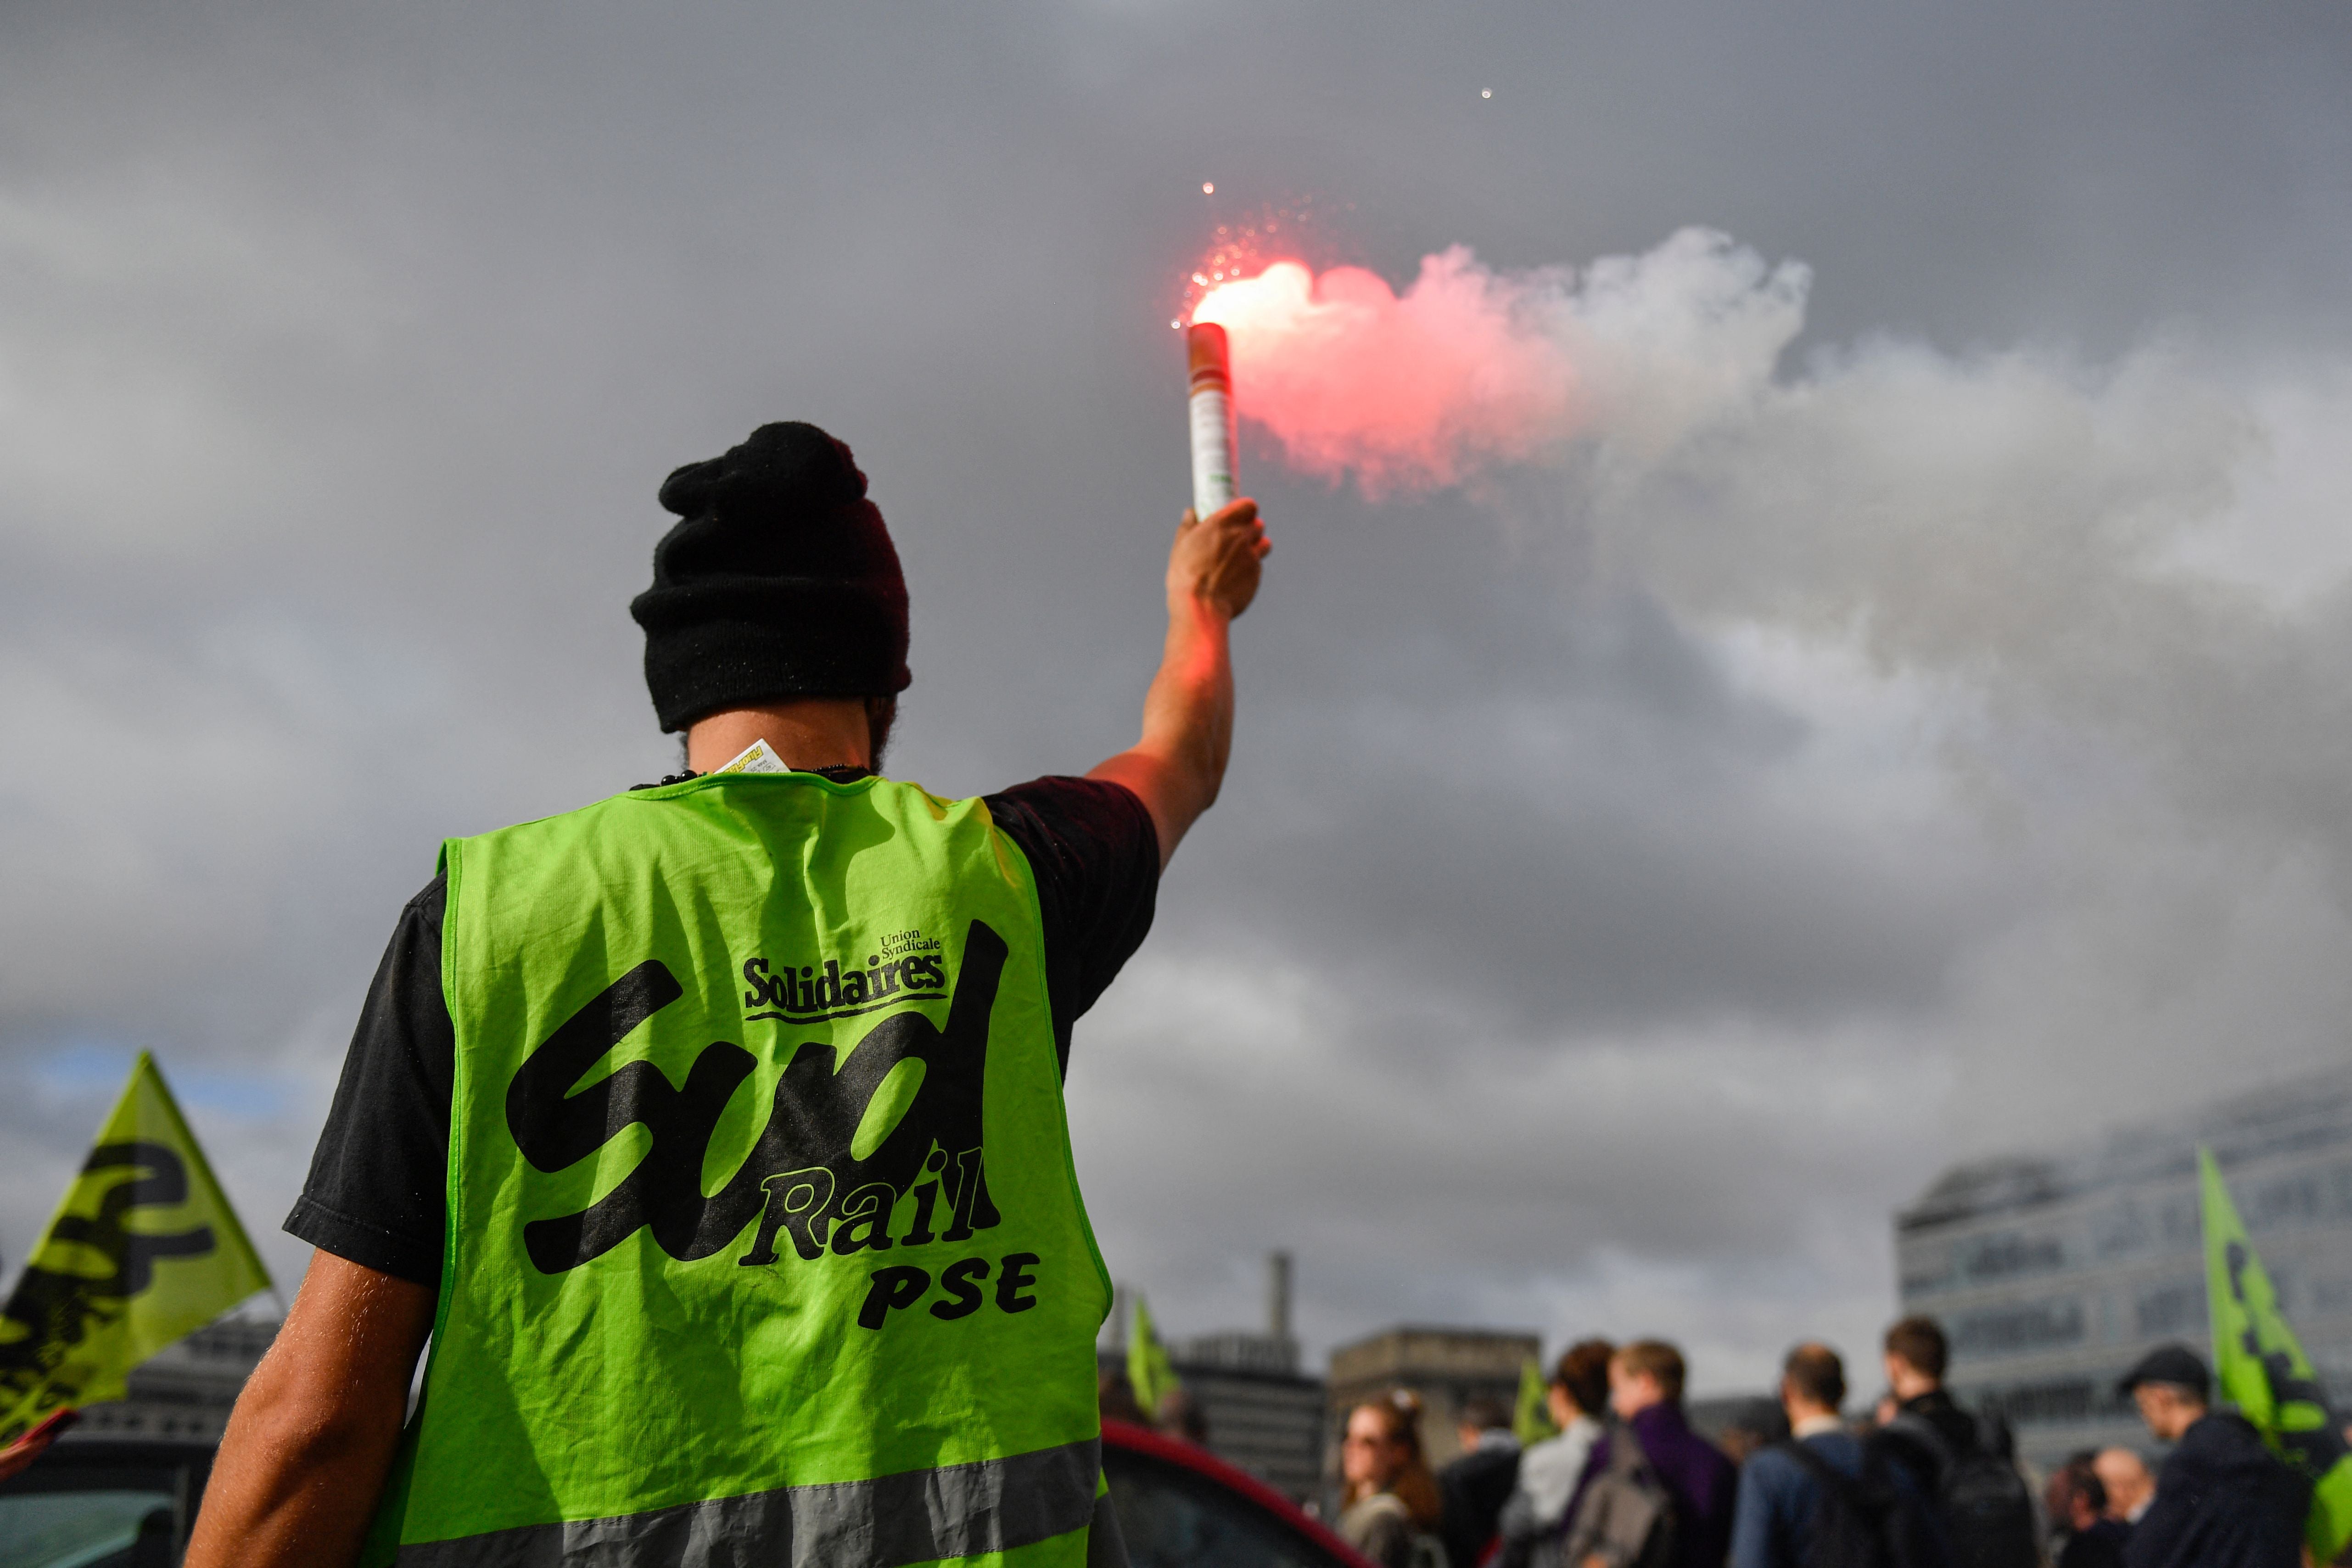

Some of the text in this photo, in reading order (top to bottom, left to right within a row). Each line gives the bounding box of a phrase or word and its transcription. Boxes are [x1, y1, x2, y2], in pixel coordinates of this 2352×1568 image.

[880, 929, 920, 947] Union
[881, 939, 941, 960] Syndicale
[743, 954, 946, 1014] Solidaires
[505, 918, 1008, 1275] Sud
[738, 1146, 983, 1266] Rail
[857, 1252, 1041, 1330] PSE
